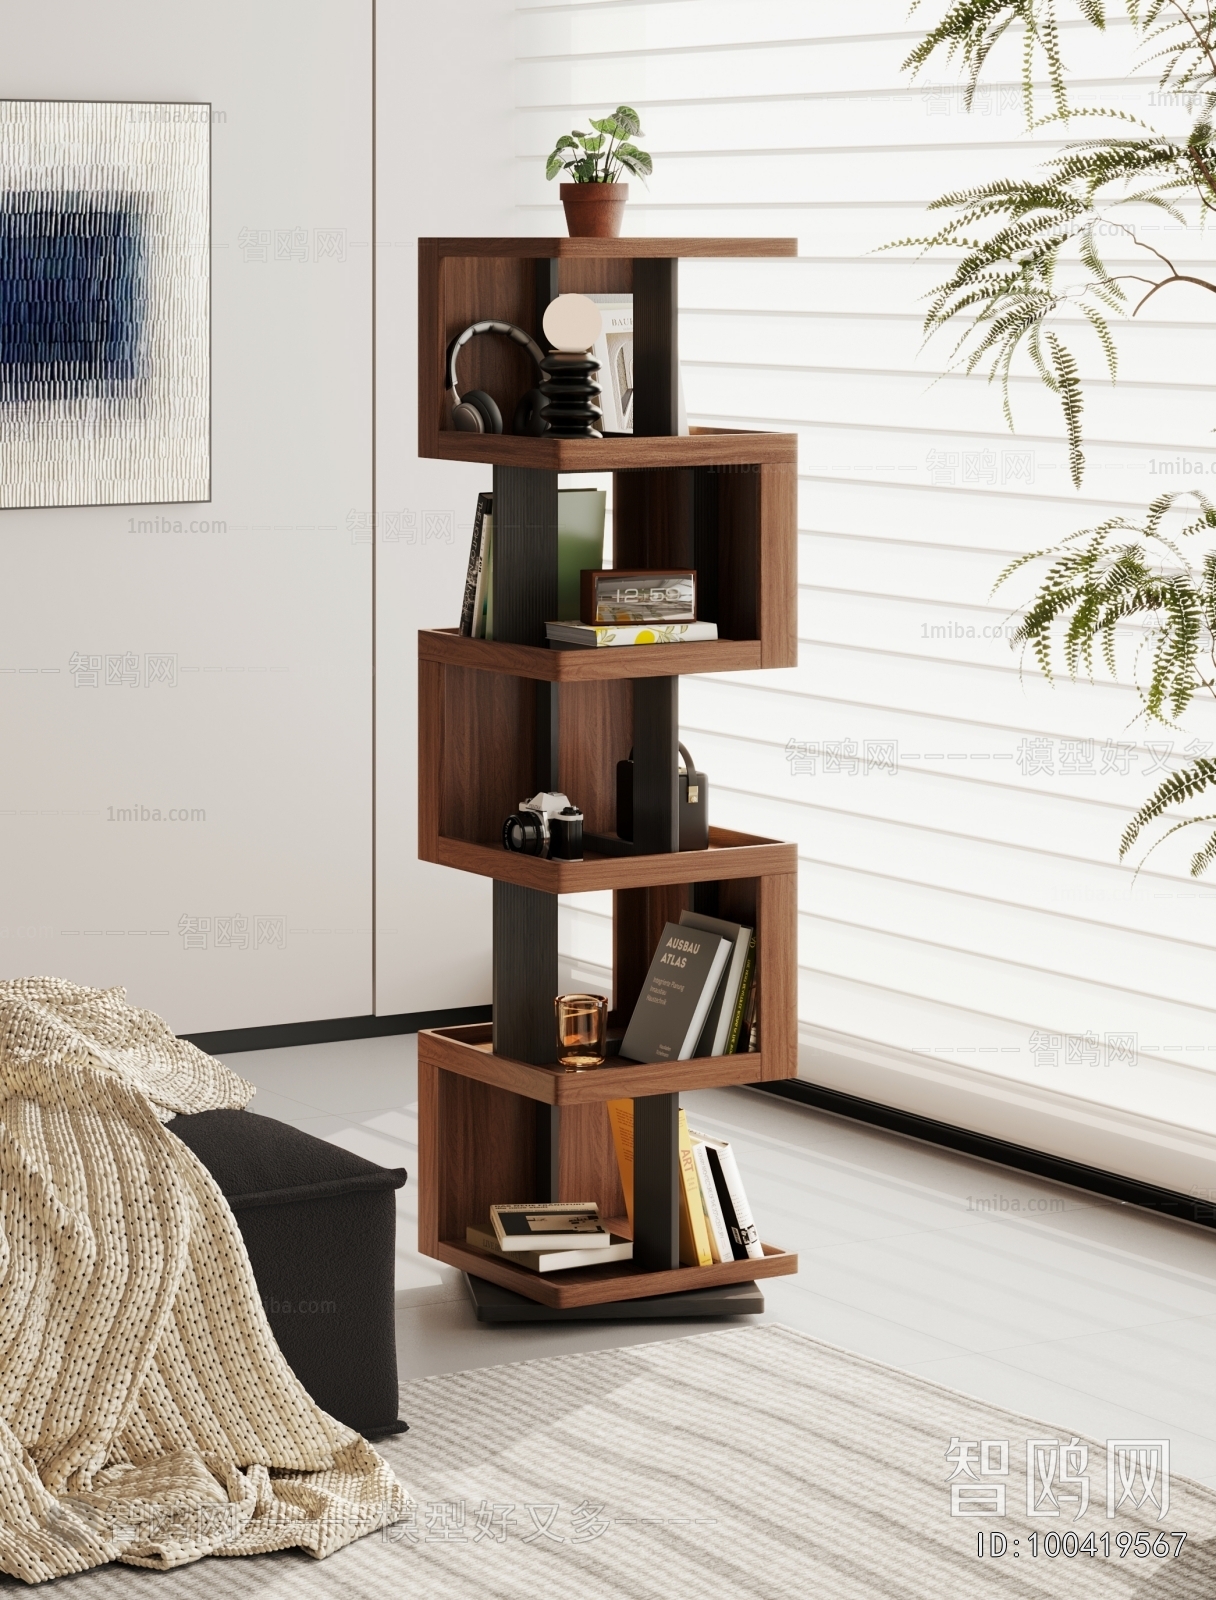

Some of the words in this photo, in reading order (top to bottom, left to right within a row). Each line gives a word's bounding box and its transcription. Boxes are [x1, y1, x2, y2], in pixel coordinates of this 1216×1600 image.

[616, 587, 680, 604] 12:59
[666, 937, 700, 955] AUSBAU
[660, 952, 687, 969] ATLAS
[680, 1149, 695, 1172] ART
